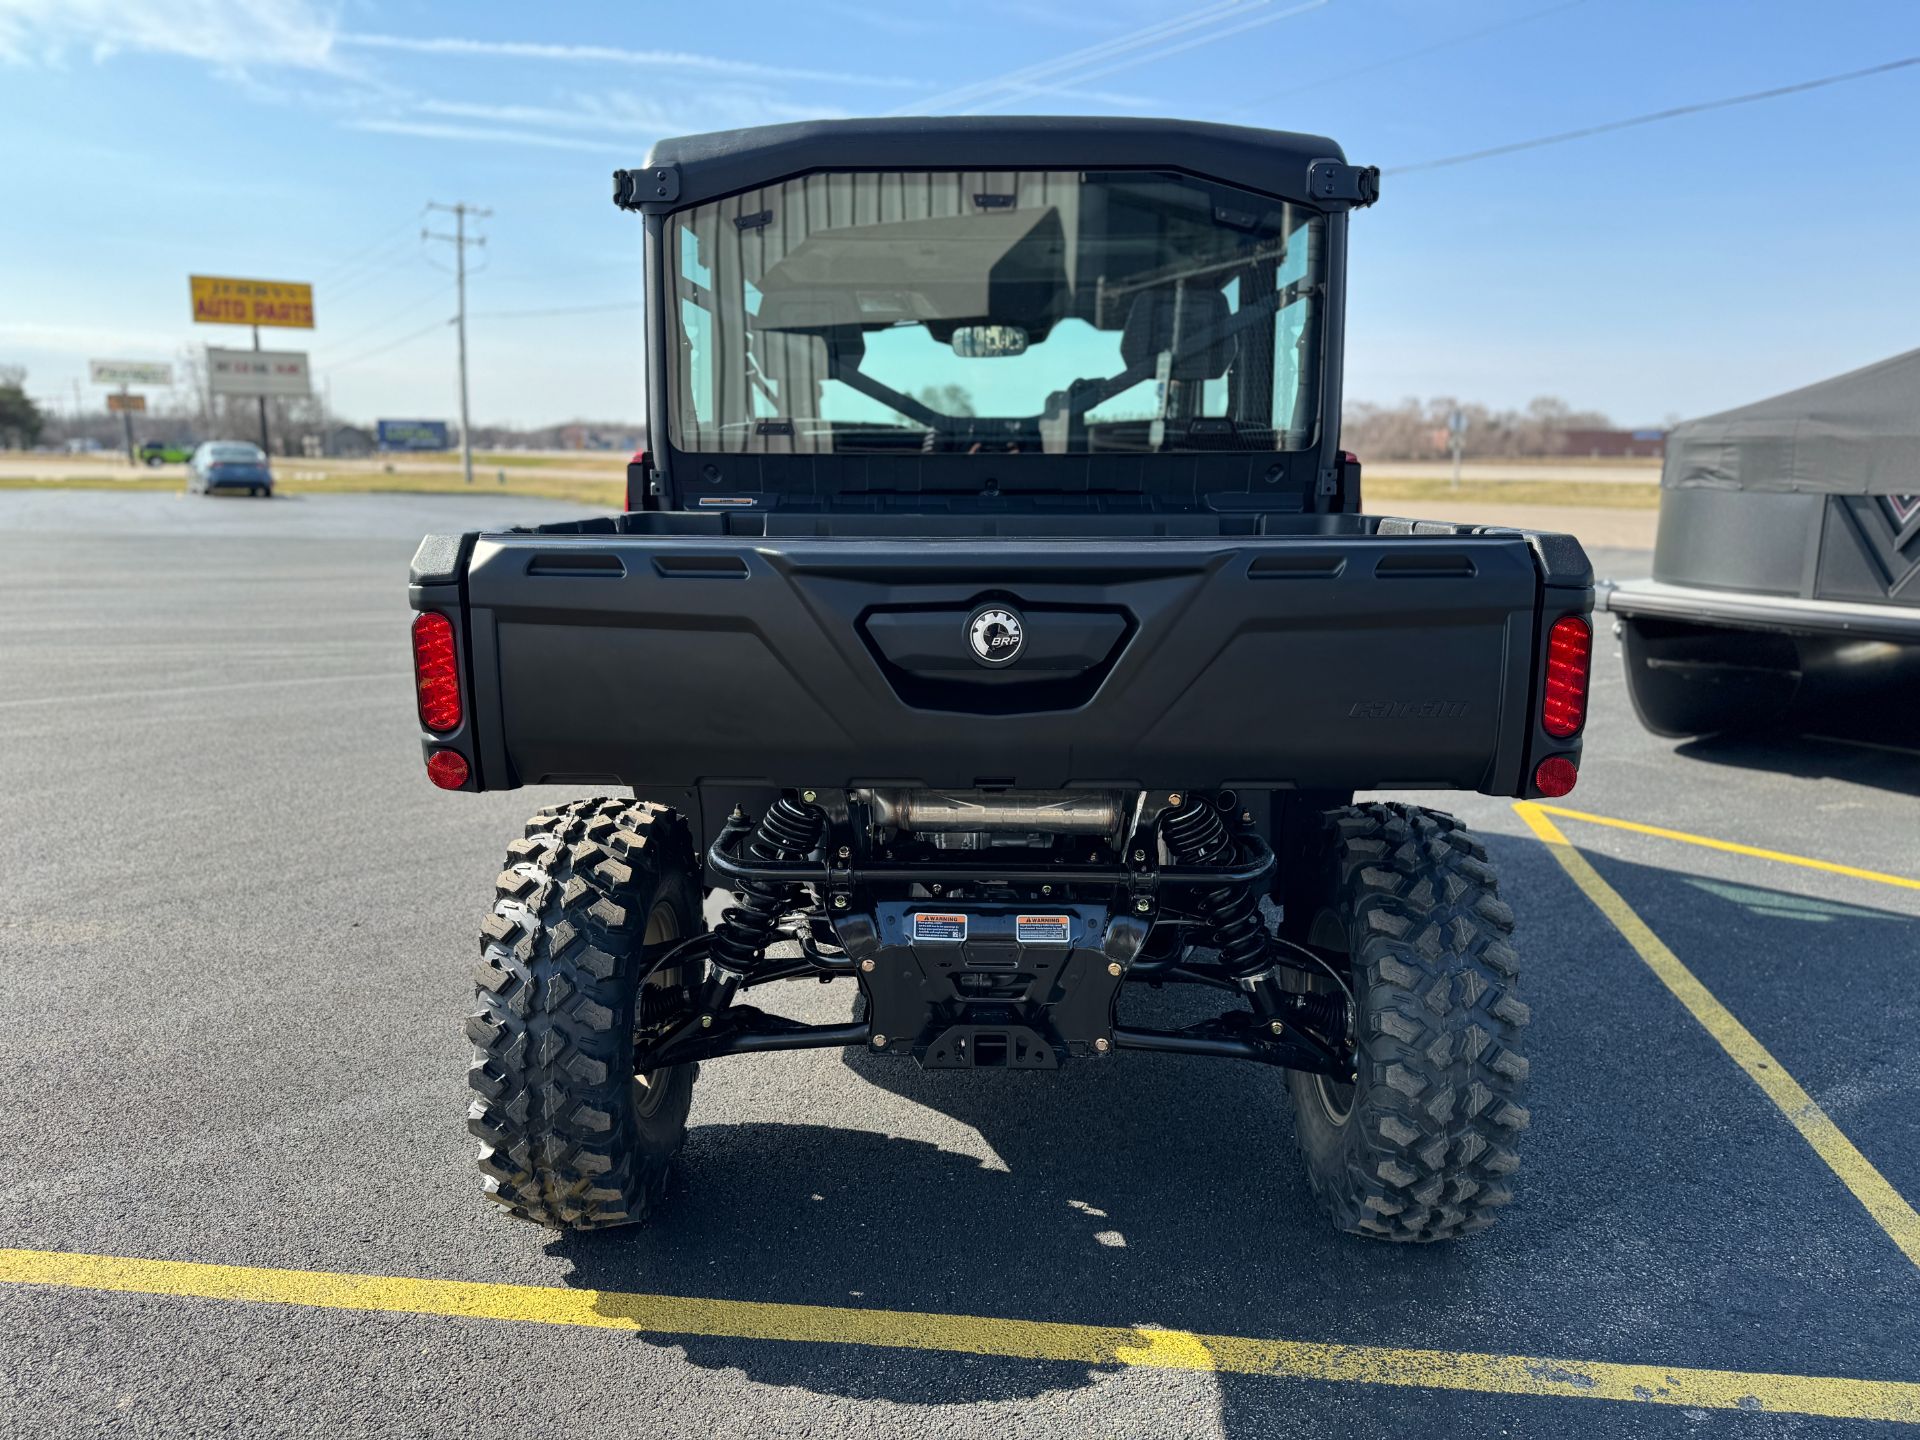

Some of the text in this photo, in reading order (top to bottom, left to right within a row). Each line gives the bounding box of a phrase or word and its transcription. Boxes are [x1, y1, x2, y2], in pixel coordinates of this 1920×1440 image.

[197, 298, 312, 322] AUTO PARTS
[991, 636, 1019, 646] BRP
